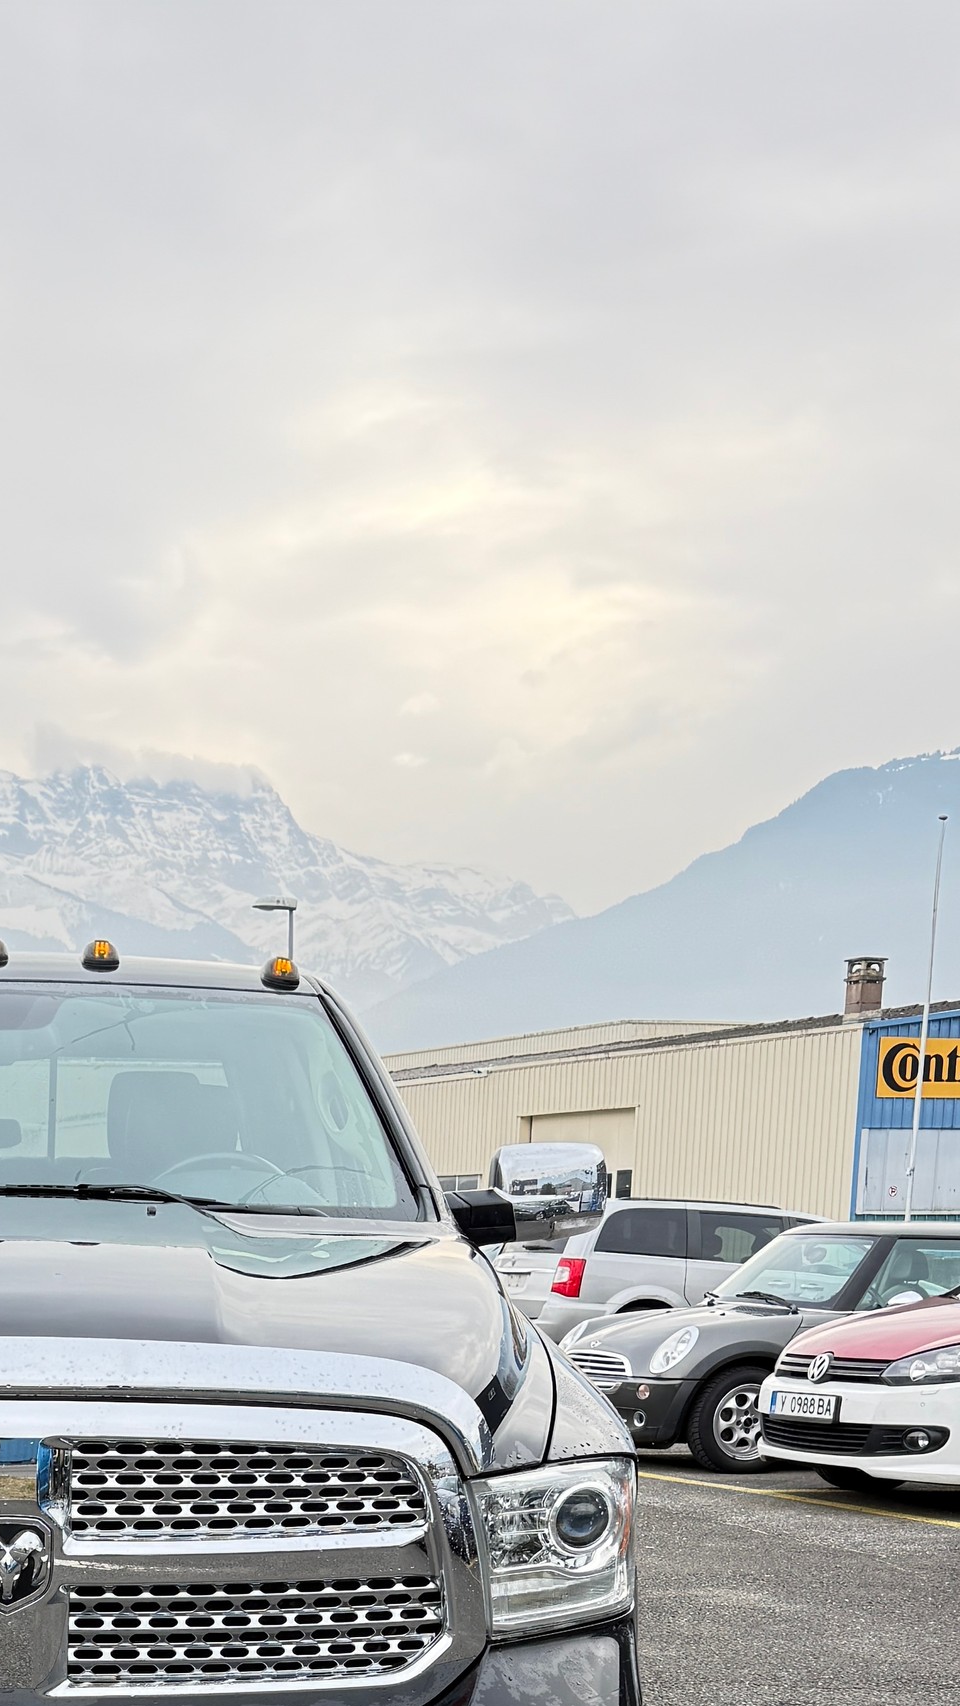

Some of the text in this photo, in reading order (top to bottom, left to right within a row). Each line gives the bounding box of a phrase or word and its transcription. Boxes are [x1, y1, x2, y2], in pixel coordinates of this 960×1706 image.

[882, 1043, 960, 1093] Cont
[791, 1396, 815, 1414] 0988
[817, 1398, 831, 1416] BA
